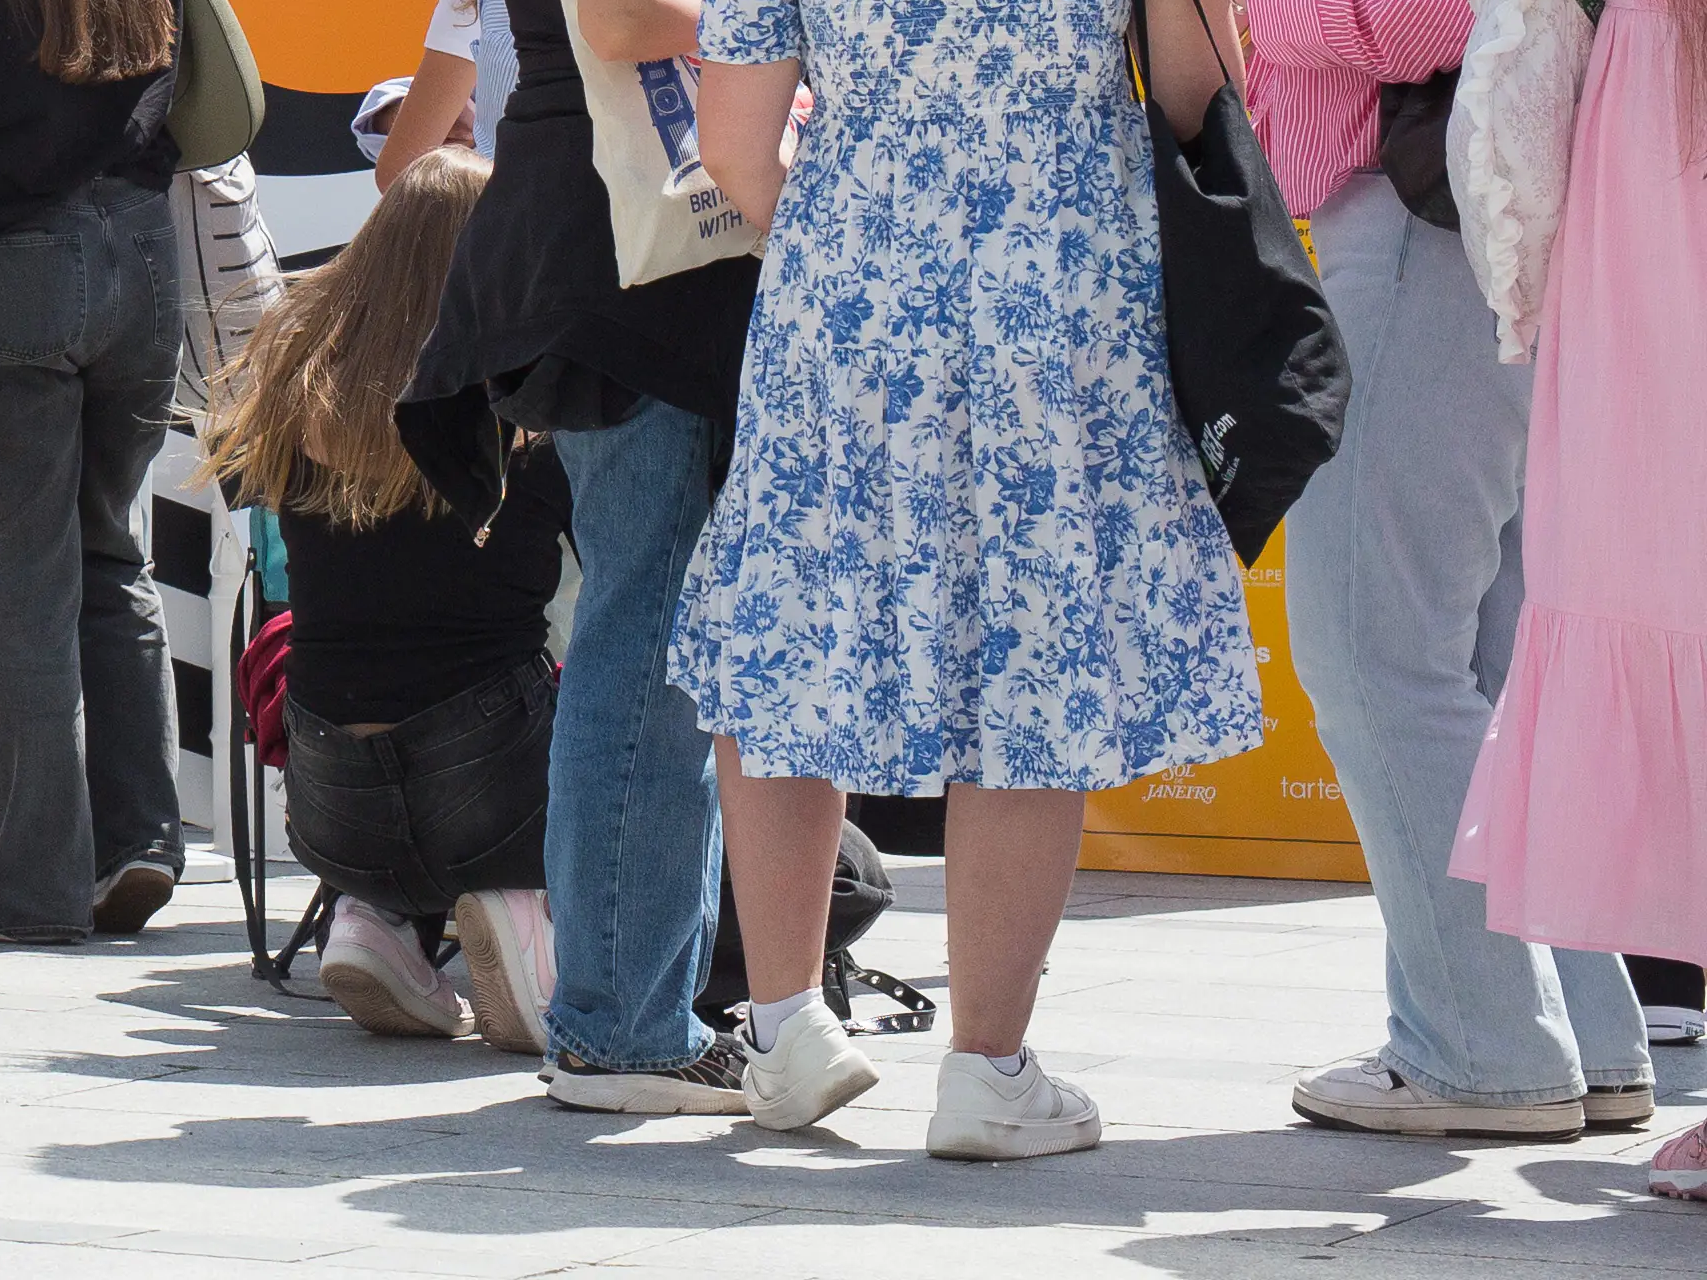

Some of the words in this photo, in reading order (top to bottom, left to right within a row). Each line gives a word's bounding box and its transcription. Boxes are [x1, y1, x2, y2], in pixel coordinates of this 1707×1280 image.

[699, 209, 742, 239] WITH
[1240, 568, 1283, 582] ECIPE
[1162, 763, 1196, 779] SOL
[1142, 783, 1217, 804] JANEIRO
[1280, 775, 1340, 800] tarte
